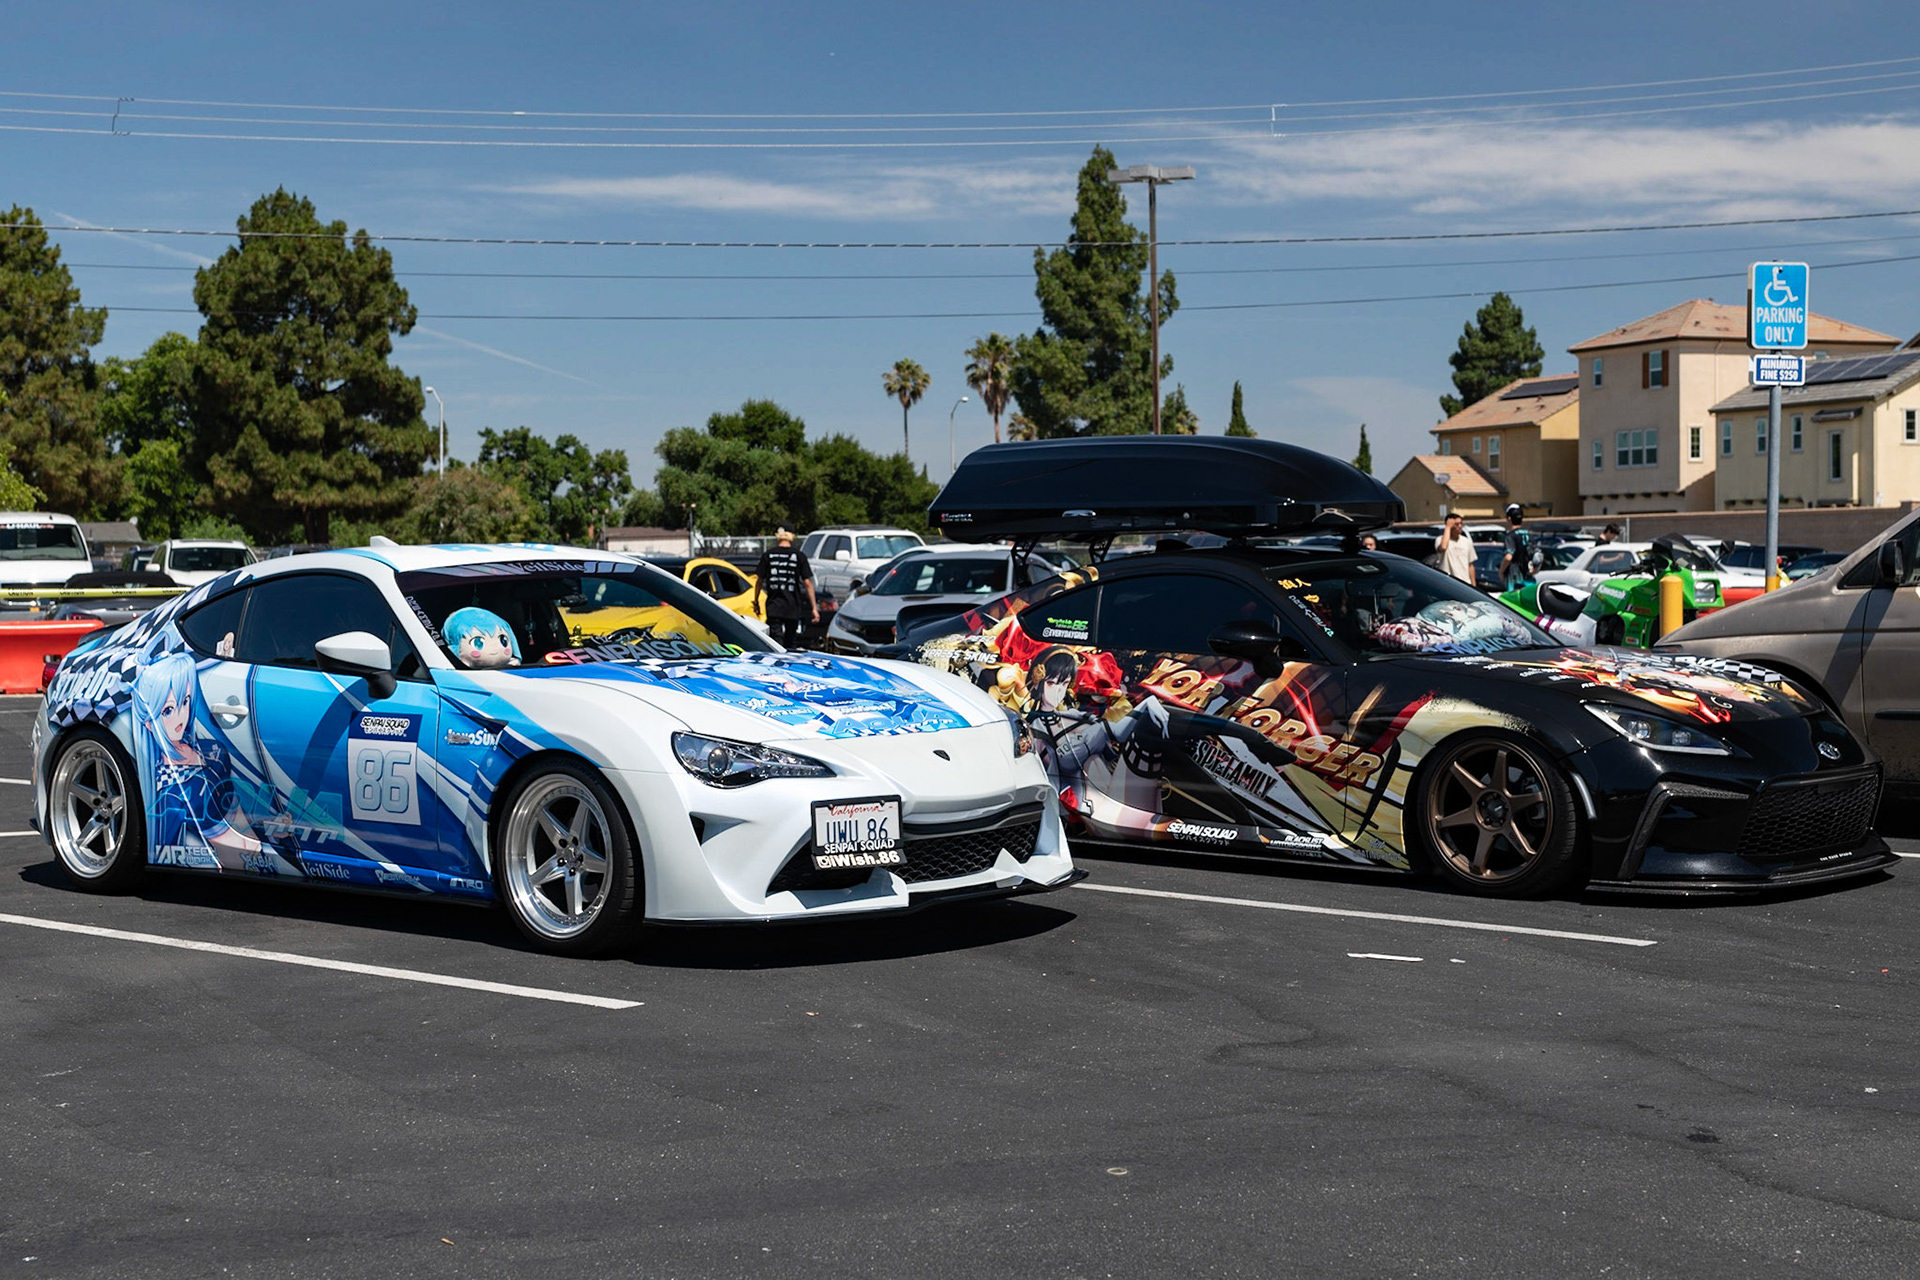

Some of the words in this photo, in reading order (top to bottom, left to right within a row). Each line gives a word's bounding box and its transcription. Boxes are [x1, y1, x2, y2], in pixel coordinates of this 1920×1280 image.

[1756, 307, 1804, 323] PARKING
[1764, 326, 1795, 343] ONLY
[1760, 358, 1799, 370] MINIMUM
[1760, 370, 1778, 380] FINE
[1779, 369, 1799, 381] $250
[507, 561, 586, 575] VeilSide
[965, 650, 999, 665] SKINS
[361, 717, 387, 728] SENPAI
[386, 718, 410, 729] SQUAD
[1144, 658, 1225, 709] YOR
[1219, 696, 1384, 784] FORGER
[355, 748, 412, 813] 86
[830, 804, 885, 818] California
[826, 820, 858, 843] UWU
[867, 817, 889, 840] 86
[1166, 822, 1203, 836] SENPAI
[1201, 825, 1238, 840] SQUAD
[824, 842, 858, 854] SENPAI
[860, 838, 895, 851] SQUAD
[302, 862, 350, 879] VeilSide
